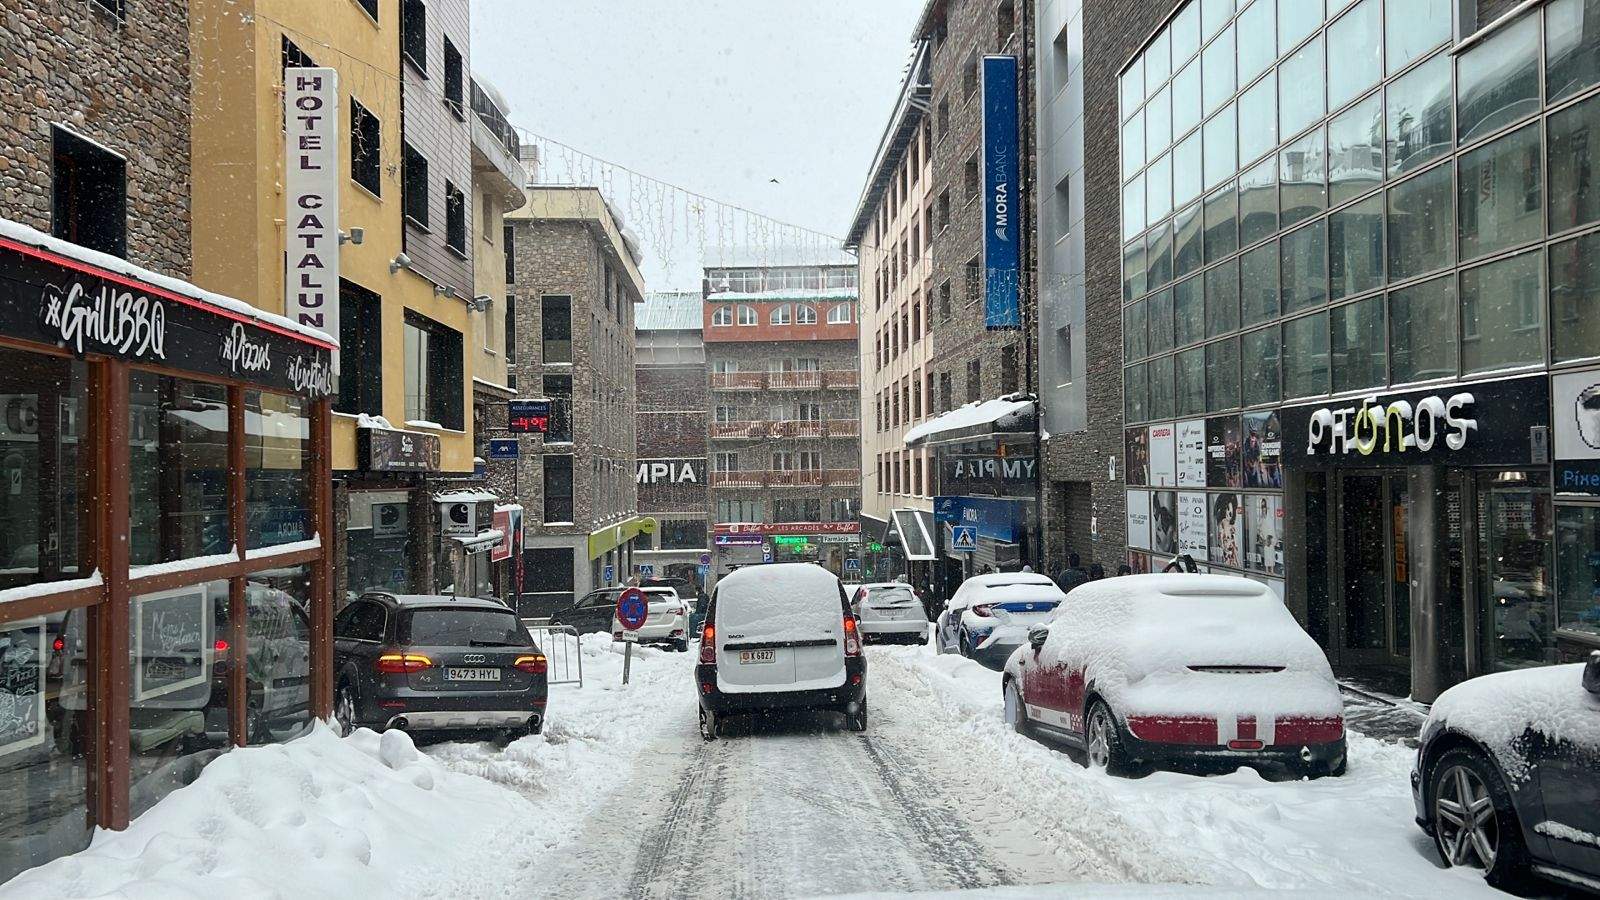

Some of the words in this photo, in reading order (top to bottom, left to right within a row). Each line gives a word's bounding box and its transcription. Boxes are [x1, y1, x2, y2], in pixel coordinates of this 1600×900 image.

[296, 77, 323, 169] HOTEL
[450, 669, 476, 680] 9473
[479, 669, 498, 679] HYL
